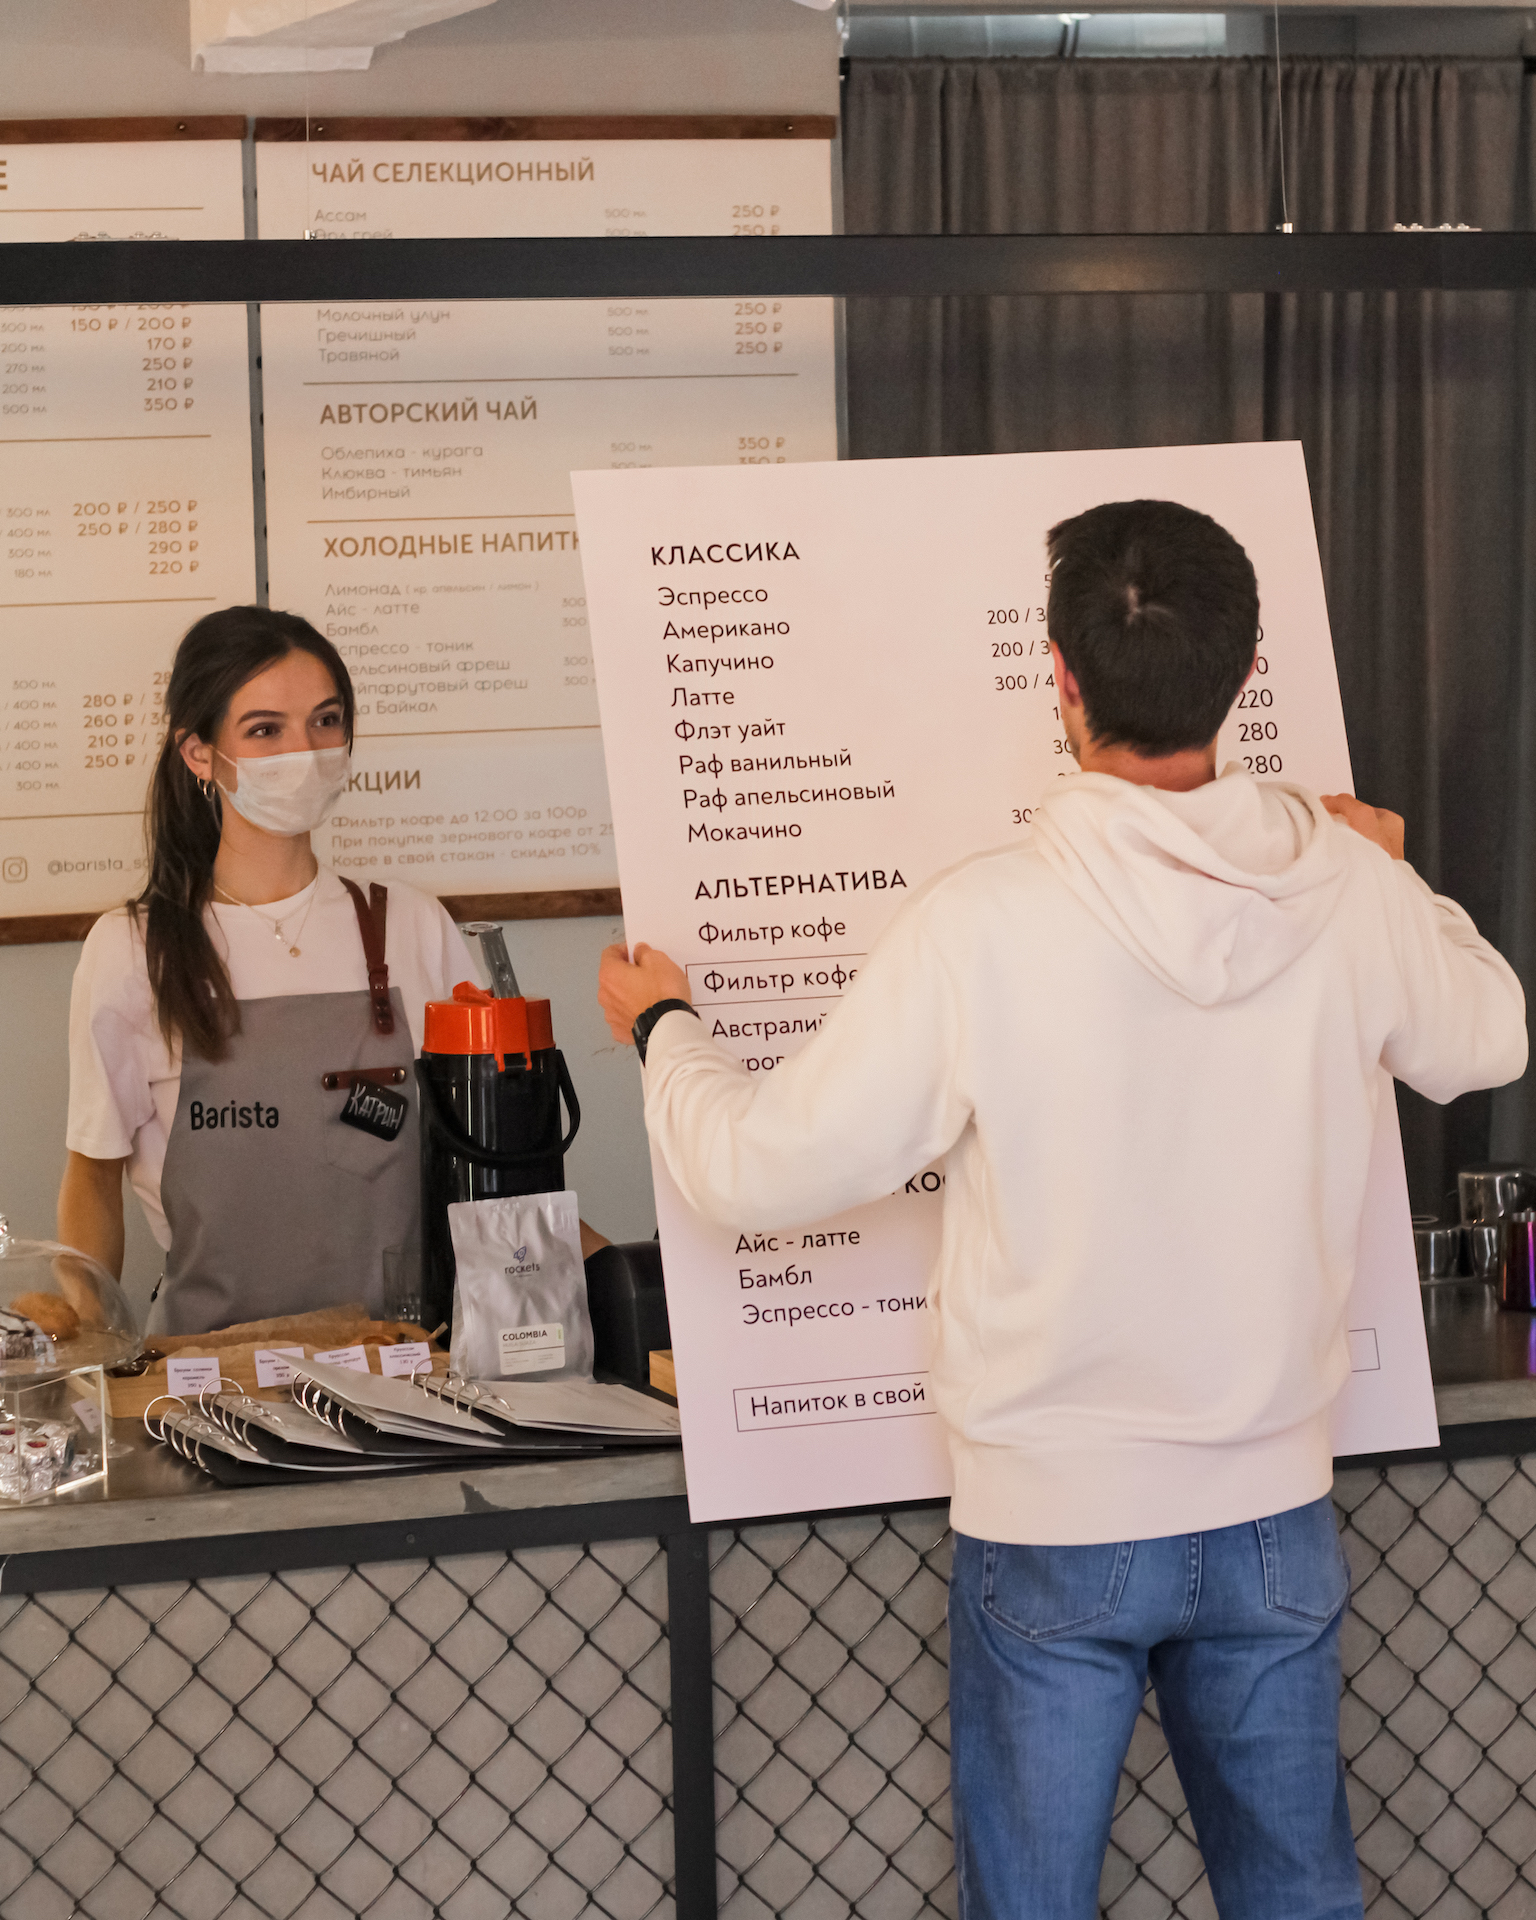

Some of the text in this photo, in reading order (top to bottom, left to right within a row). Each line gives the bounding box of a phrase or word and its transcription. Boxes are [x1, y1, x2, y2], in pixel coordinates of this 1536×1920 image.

[312, 157, 594, 185] ЧАЙ СЕЛЕКЦИОННЫЙ
[314, 205, 779, 222] Ассам 500 250 ₽
[734, 225, 764, 236] 250
[317, 302, 781, 324] Молочный улун 500 250 ₽
[71, 318, 102, 332] 150
[108, 319, 118, 330] ₽
[138, 317, 175, 331] 200
[181, 317, 191, 329] ₽
[318, 322, 782, 344] Гречишный 500 250 ₽
[0, 337, 192, 354] 200 170 ₽
[319, 341, 782, 364] Травяной 500 250 ₽
[5, 357, 192, 374] 270 250 ₽
[2, 377, 193, 394] 200 210 ₽
[145, 398, 178, 411] 350
[184, 398, 194, 409] ₽
[320, 396, 537, 424] АВТОРСКИЙ ЧАЙ
[320, 437, 785, 461] Облепиха курага 500 350 ₽
[321, 467, 462, 480] Клюква тимьян
[322, 486, 410, 501] Имбирный
[73, 502, 111, 517] 200
[117, 502, 127, 514] ₽
[147, 500, 181, 514] 250
[187, 500, 197, 512] ₽
[7, 520, 198, 538] 400 250 ₽ 280 ₽
[8, 540, 198, 559] 300 290 ₽
[324, 534, 473, 559] ХОЛОДНЫЕ
[651, 542, 800, 565] КЛАССИКА
[149, 561, 183, 575] 220
[189, 561, 199, 572] ₽
[325, 584, 401, 596] Лимонад
[658, 587, 768, 610] Эспрессо
[326, 597, 586, 616] Айс латте 300
[326, 617, 587, 636] Бамбл 300
[663, 621, 790, 643] Американо
[987, 609, 1019, 625] 200
[426, 642, 473, 653] тоник
[349, 656, 588, 675] ельсиновый фреш 300
[667, 654, 774, 677] Капучино
[992, 642, 1023, 658] 200
[13, 680, 38, 690] 300
[474, 679, 528, 692] фреш
[564, 676, 588, 686] 300
[671, 687, 734, 707] Латте
[995, 675, 1027, 691] 300
[1237, 688, 1274, 710] 220
[13, 694, 117, 710] 400 280
[376, 700, 437, 715] Байкал
[13, 714, 118, 731] 400 260
[674, 719, 1278, 743] Флэт уайт 280
[14, 734, 118, 751] 400 210
[15, 754, 119, 771] 400 250
[679, 749, 1283, 779] Раф ванильный 280
[17, 781, 42, 791] 300
[683, 780, 895, 812] Раф апельсиновый
[331, 816, 394, 828] Фильтр
[400, 815, 444, 827] кофе
[450, 814, 469, 825] до
[524, 810, 541, 820] за
[547, 806, 588, 820] 100р
[331, 826, 593, 850] При покупке зернового кофе от
[688, 823, 802, 842] Мокачино
[332, 843, 601, 867] Кофе в свой стакан скидка 10%
[695, 870, 907, 900] АЛЬТЕРНАТИВА
[698, 917, 846, 945] Фильтр кофе
[704, 970, 794, 993] Фильтр
[190, 1100, 279, 1130] Barista
[905, 1171, 946, 1194] КО
[735, 1231, 860, 1254] Айс латте
[505, 1262, 540, 1274] rockets
[739, 1265, 812, 1289] Бамбл
[743, 1294, 928, 1327] Эспрессо тони
[502, 1330, 547, 1341] COLOMBIA
[751, 1382, 925, 1416] Напиток в свой
